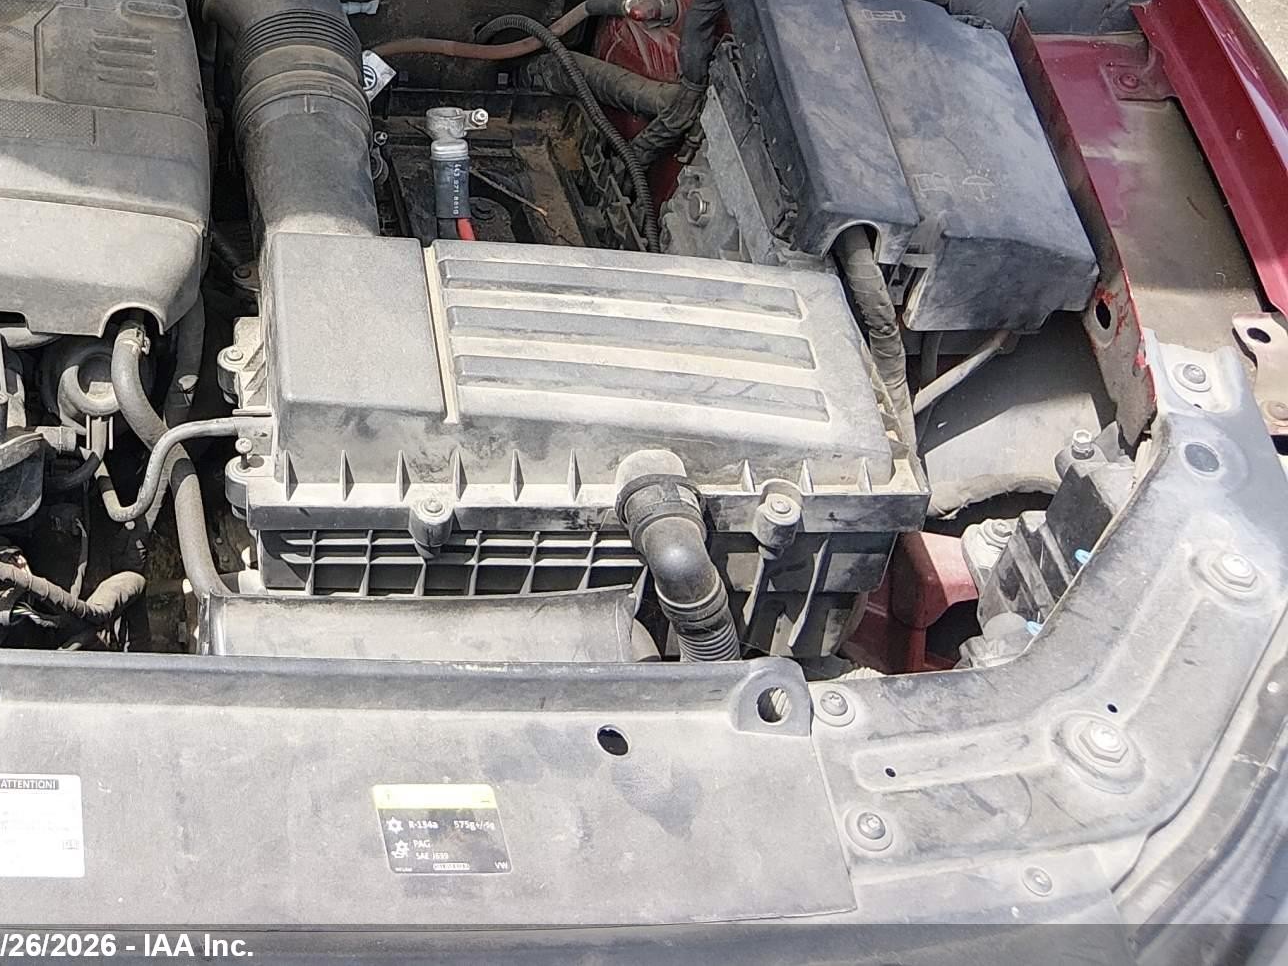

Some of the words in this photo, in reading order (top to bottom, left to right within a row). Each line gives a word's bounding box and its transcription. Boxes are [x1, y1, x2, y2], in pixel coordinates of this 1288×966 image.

[1, 780, 57, 790] ATTENTION!
[412, 840, 431, 849] PAG
[415, 852, 430, 860] SAE
[494, 861, 508, 870] VW
